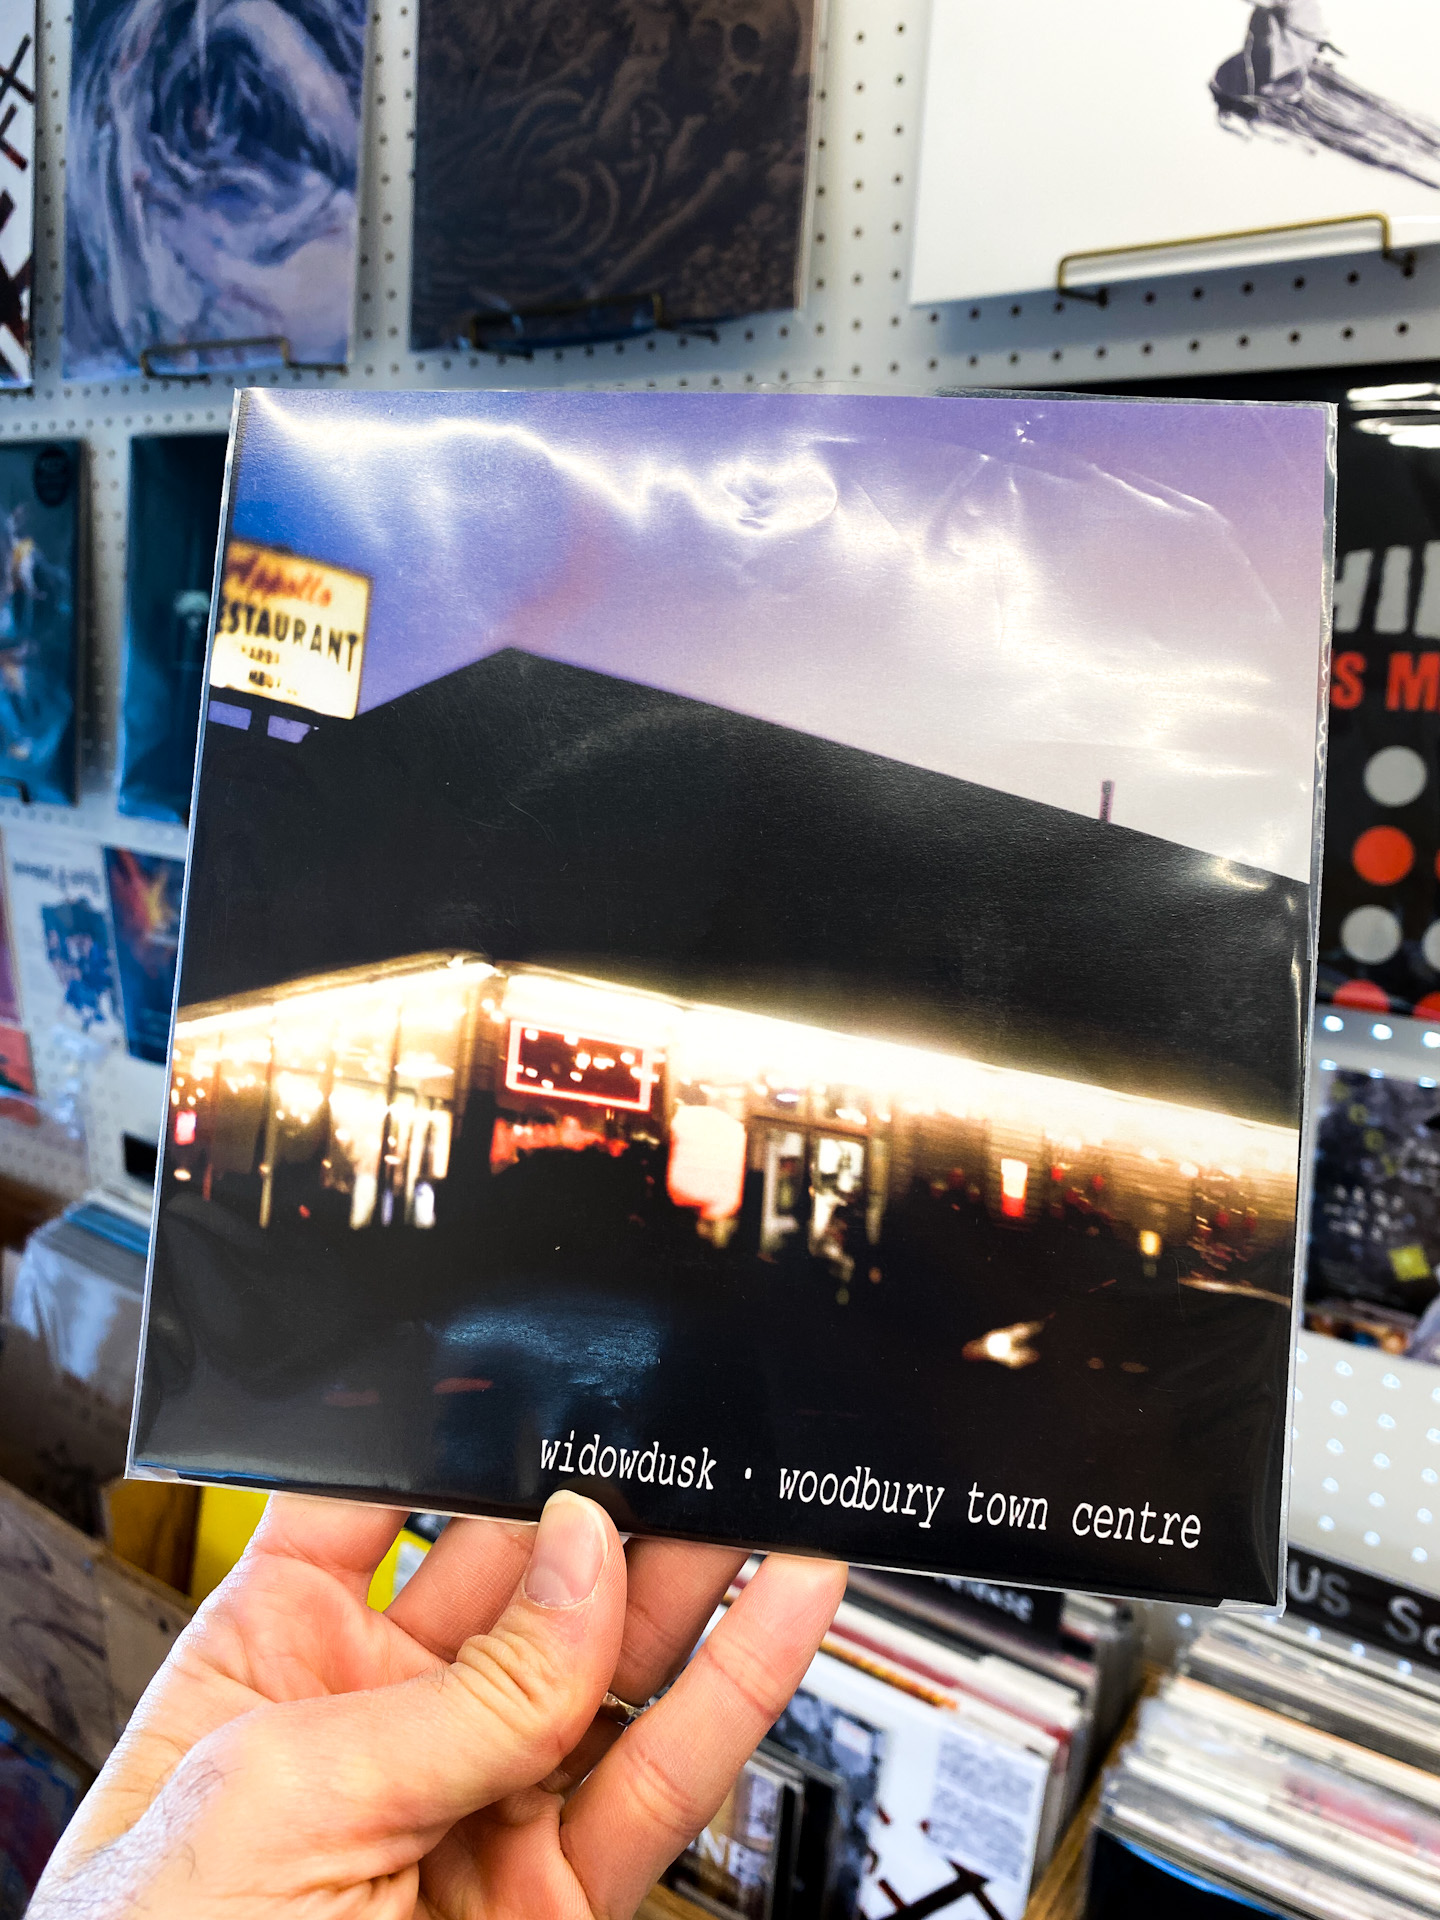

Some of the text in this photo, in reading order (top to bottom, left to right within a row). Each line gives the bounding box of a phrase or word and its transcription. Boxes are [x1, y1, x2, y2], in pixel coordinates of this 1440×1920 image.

[540, 1430, 717, 1491] widowdusk
[778, 1465, 945, 1529] woodbury
[967, 1481, 1048, 1531] town
[1071, 1501, 1202, 1549] centre
